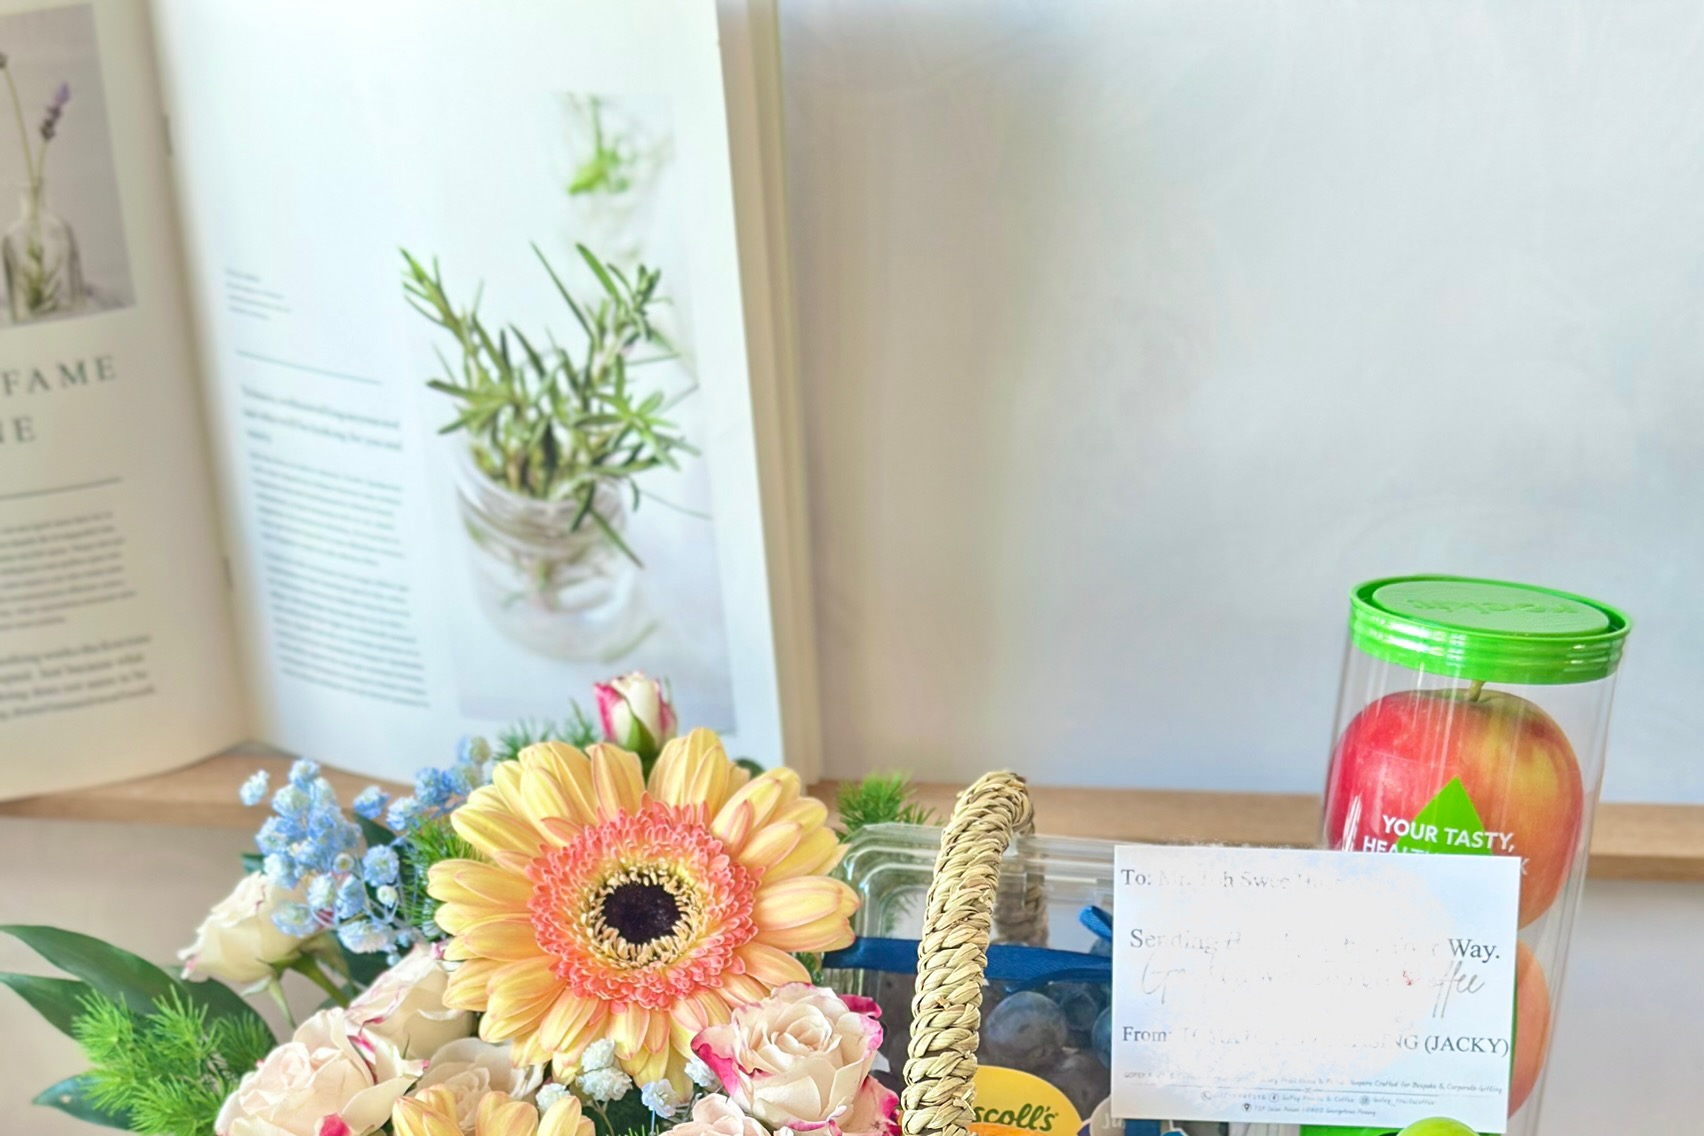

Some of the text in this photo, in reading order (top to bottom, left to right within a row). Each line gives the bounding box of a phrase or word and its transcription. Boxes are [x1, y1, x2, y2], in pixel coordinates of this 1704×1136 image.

[1, 354, 117, 397] FAME
[1383, 815, 1437, 843] YOUR
[1444, 828, 1515, 852] TASTY,
[1120, 869, 1151, 886] To:
[1448, 938, 1501, 963] Way.
[1424, 1034, 1509, 1057] (JACKY)
[972, 1103, 1058, 1132] scoll's
